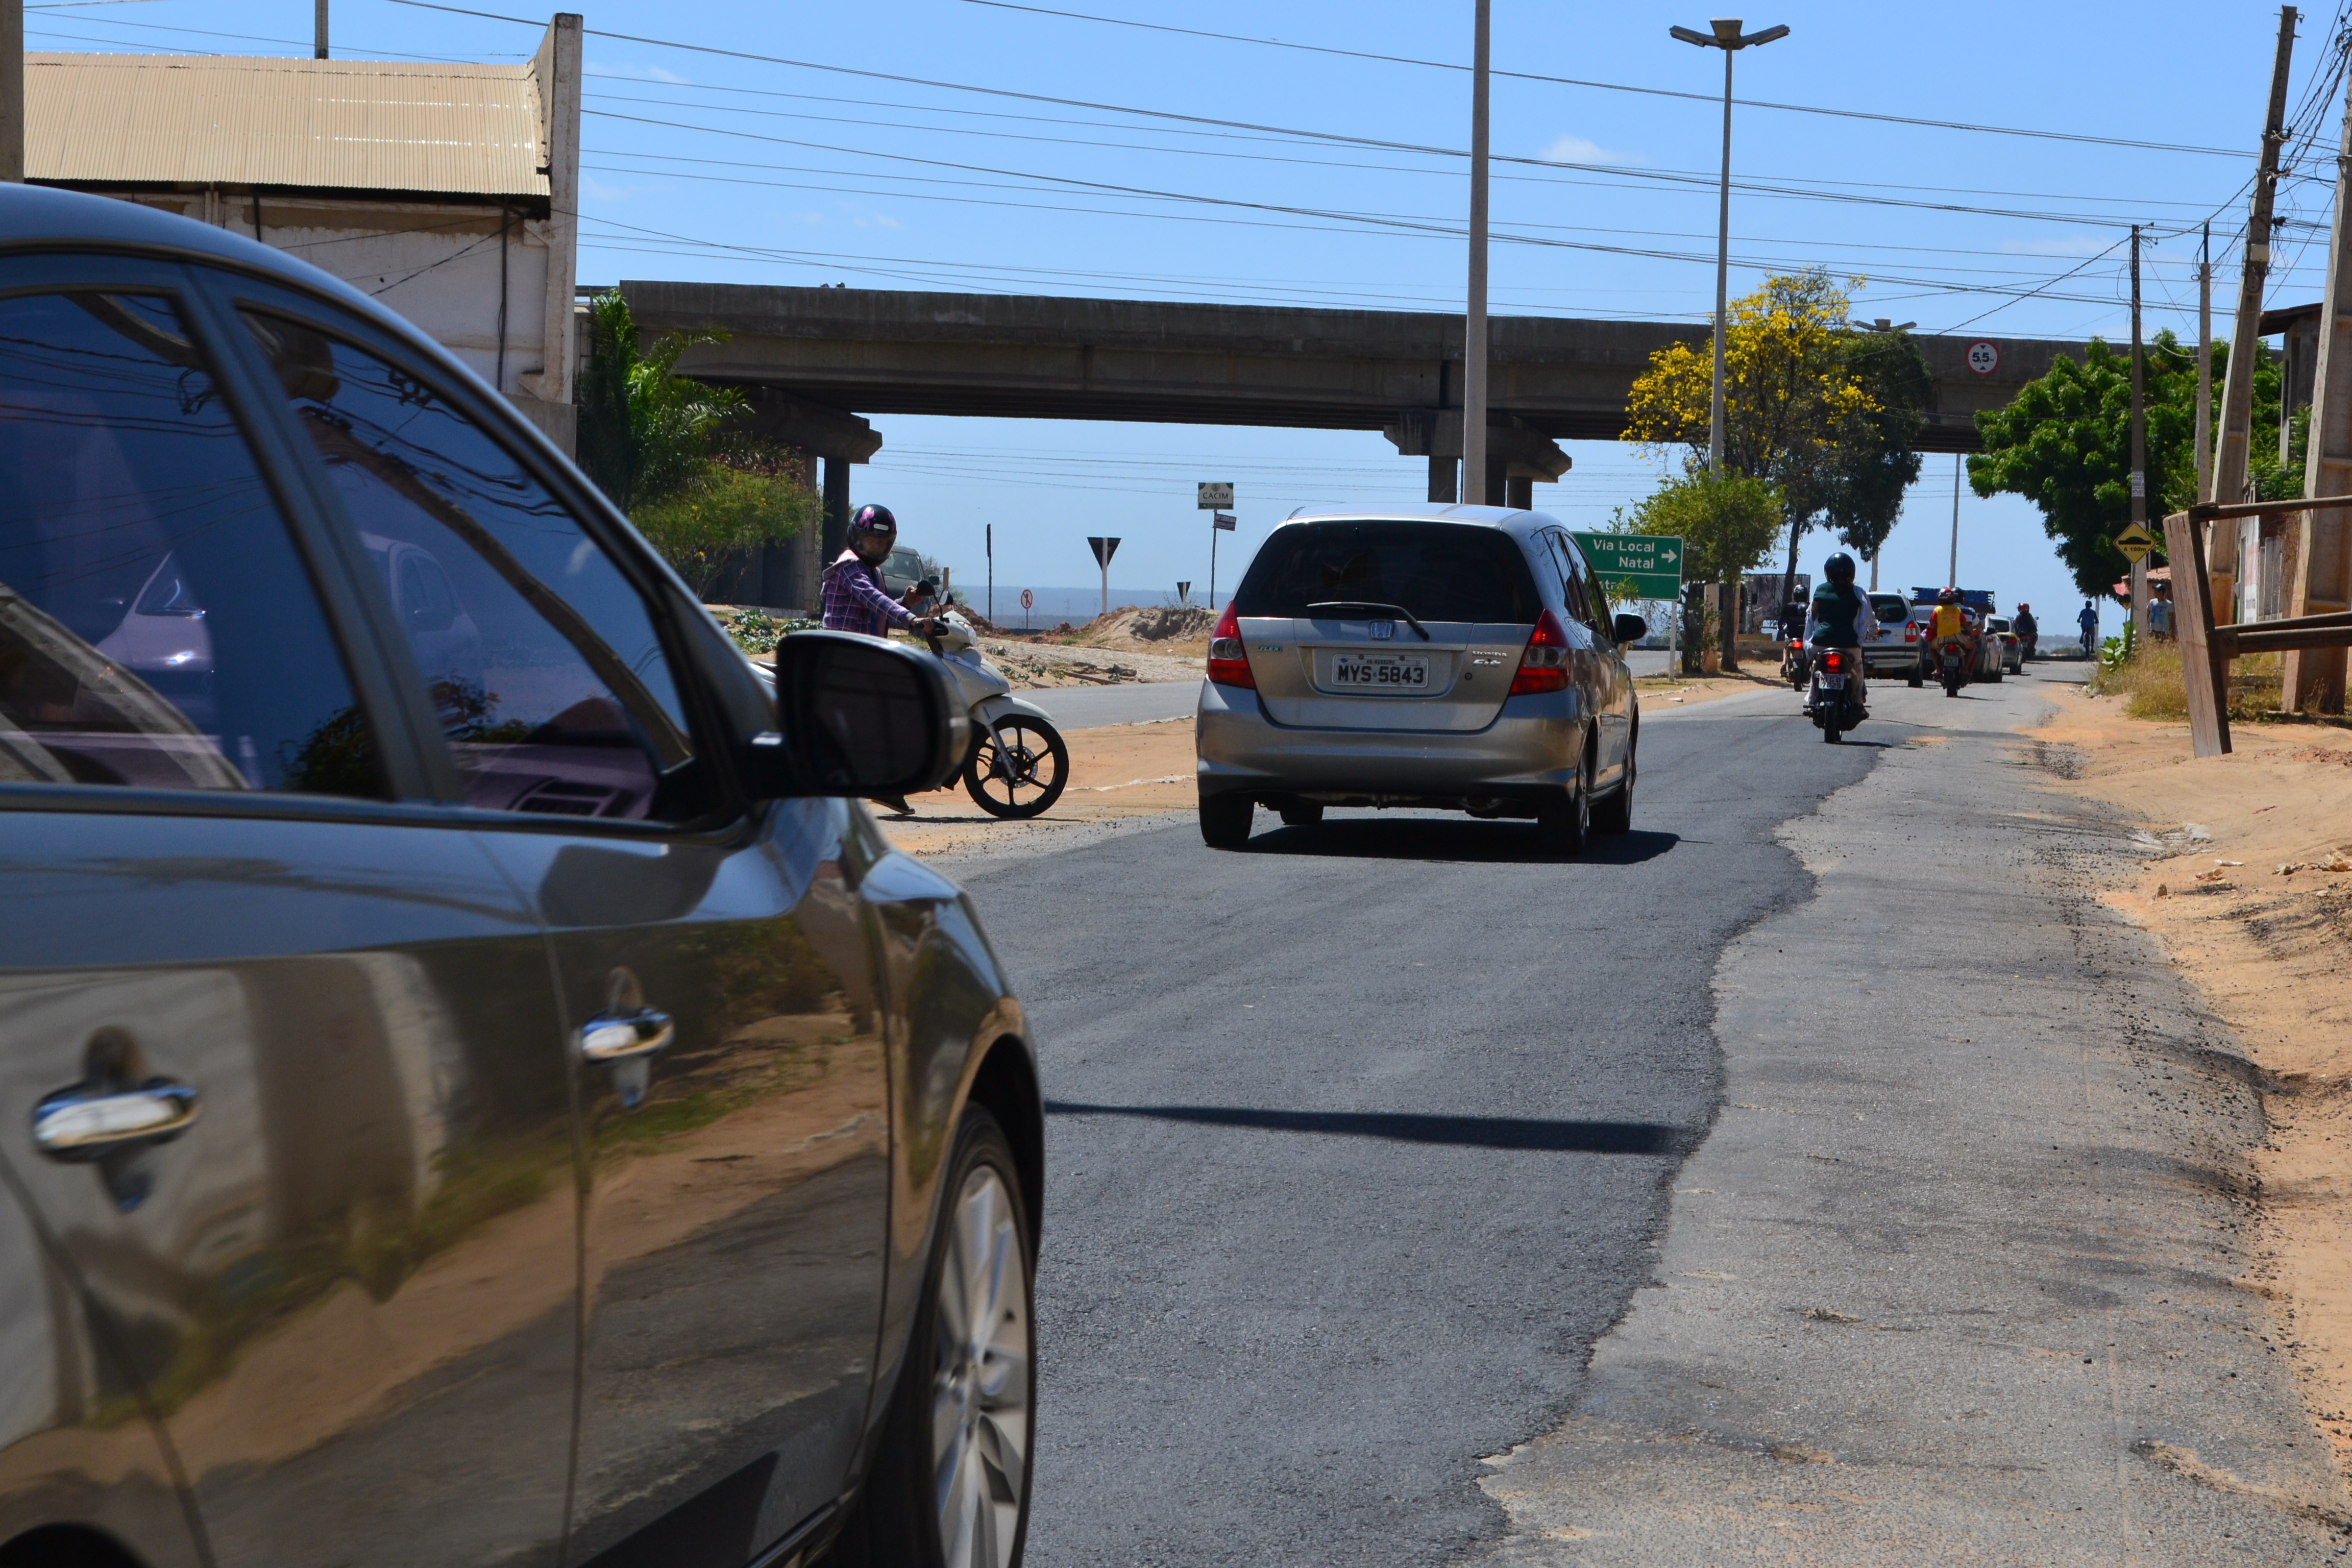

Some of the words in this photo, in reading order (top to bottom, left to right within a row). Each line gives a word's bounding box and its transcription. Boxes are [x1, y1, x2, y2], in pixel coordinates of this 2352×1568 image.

[1593, 539, 1613, 550] Via
[1619, 541, 1655, 552] Local
[1619, 556, 1654, 569] Natal
[1338, 665, 1371, 682] MYS
[1378, 666, 1424, 683] 5843
